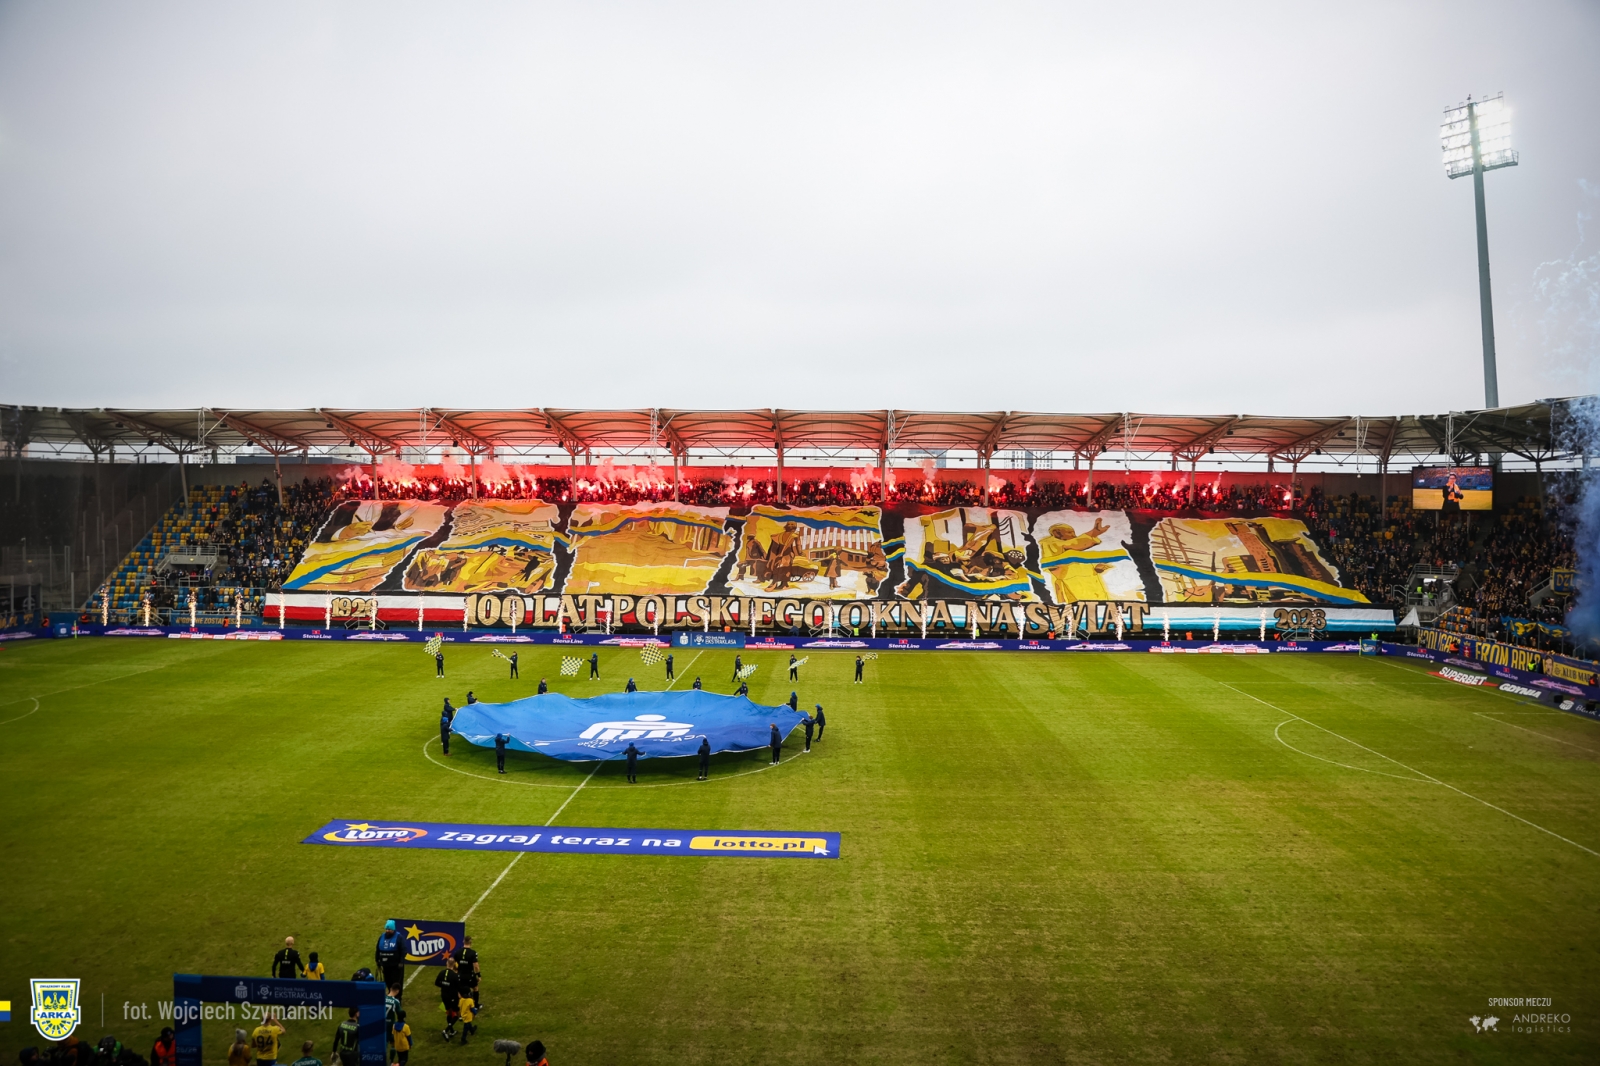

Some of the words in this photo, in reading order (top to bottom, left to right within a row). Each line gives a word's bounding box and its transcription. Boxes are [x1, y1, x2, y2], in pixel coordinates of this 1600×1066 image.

[465, 594, 526, 626] 100
[532, 594, 604, 627] LAT
[610, 595, 835, 630] POLSKIEGO
[839, 599, 955, 631] OKNA
[964, 601, 1017, 632] NA
[1438, 666, 1488, 686] SUPERBET
[1499, 682, 1542, 698] GDYNIA
[344, 830, 409, 839] LOTTO
[437, 831, 541, 846] Zagraj
[550, 835, 633, 846] teraz
[642, 838, 682, 847] na
[714, 839, 806, 850] lotto.pl
[410, 938, 445, 955] LOTTO
[274, 991, 323, 1000] EKSTRAKLASA
[256, 1035, 274, 1048] 94
